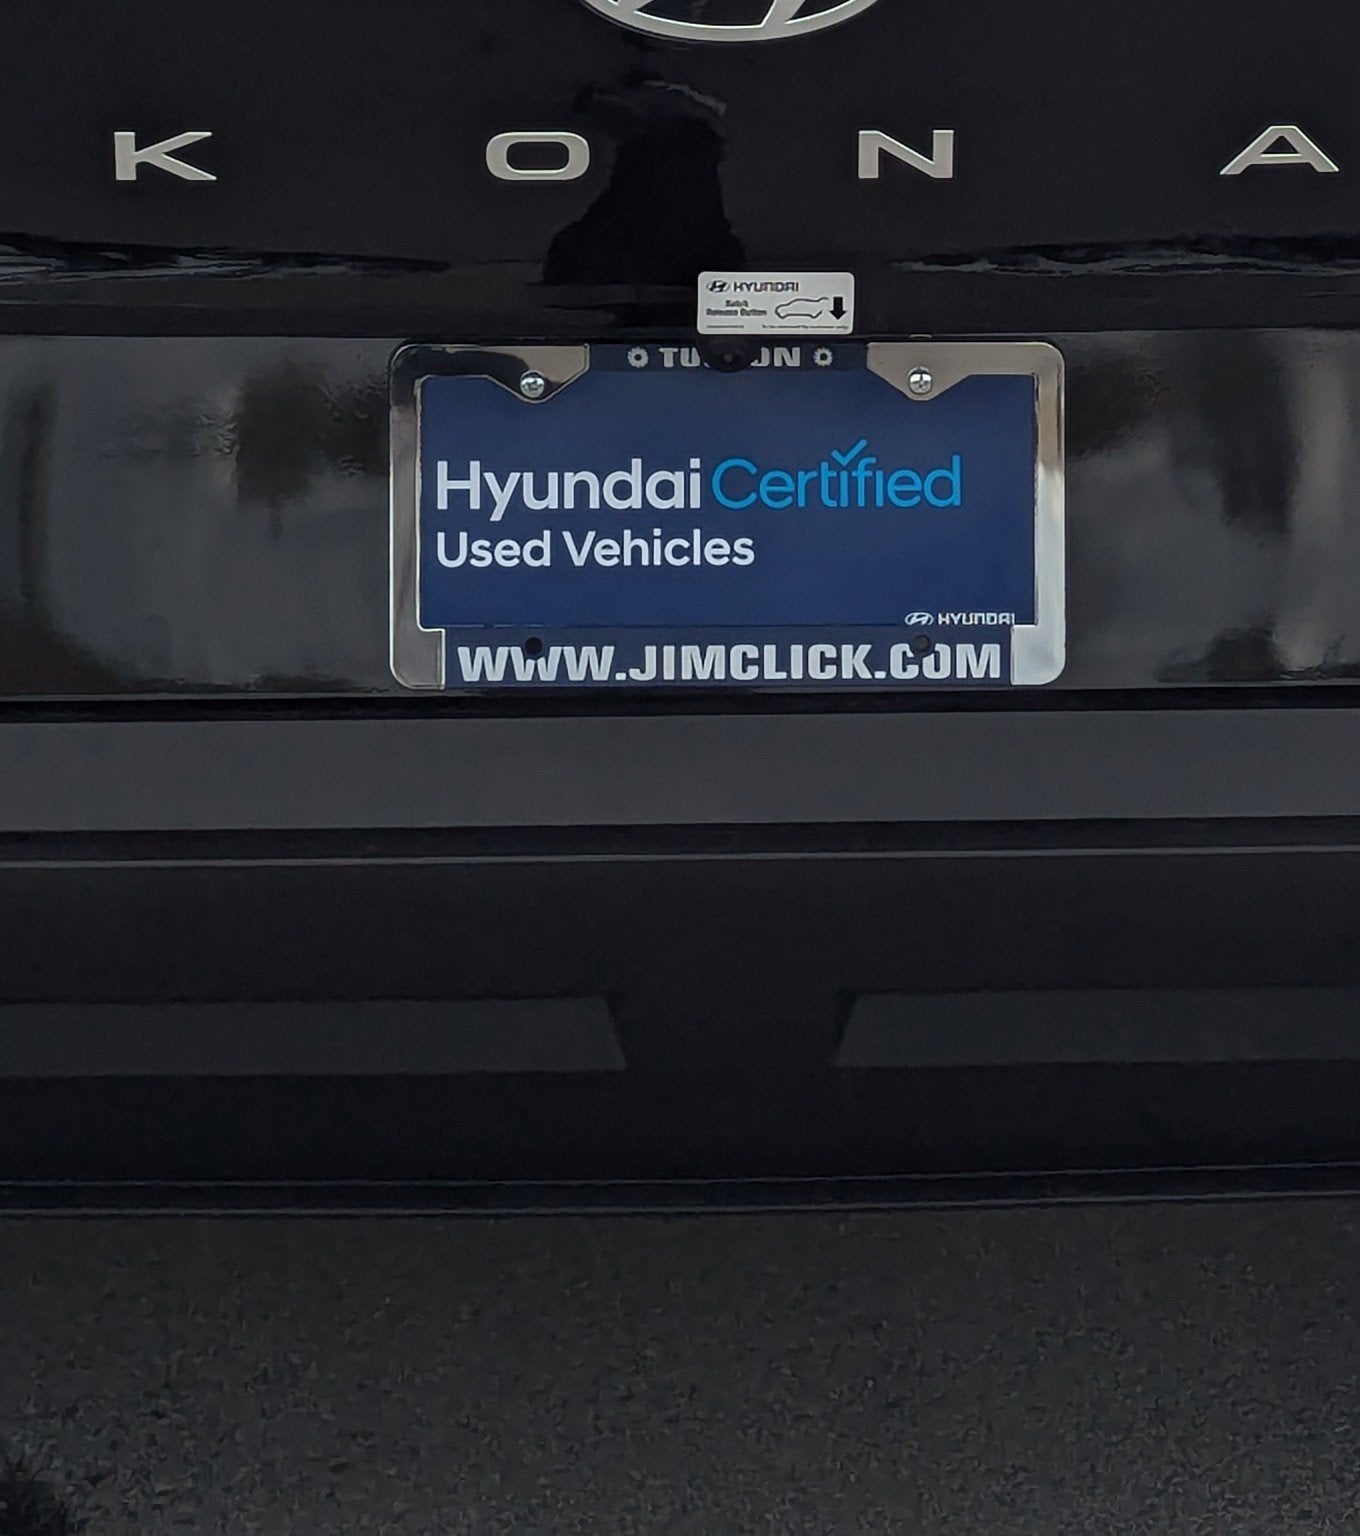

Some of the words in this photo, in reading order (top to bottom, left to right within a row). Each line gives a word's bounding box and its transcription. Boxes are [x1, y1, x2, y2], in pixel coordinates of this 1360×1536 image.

[114, 125, 1339, 181] KONA
[733, 281, 799, 293] HYUNDAI
[659, 346, 801, 368] TUON
[437, 457, 701, 521] Hyundai
[711, 439, 962, 510] Certified
[437, 529, 551, 567] Used
[562, 528, 756, 567] Vehicles
[937, 612, 1016, 625] HYUNDAI
[456, 642, 1001, 682] WWW.JIMCLICK.COM
